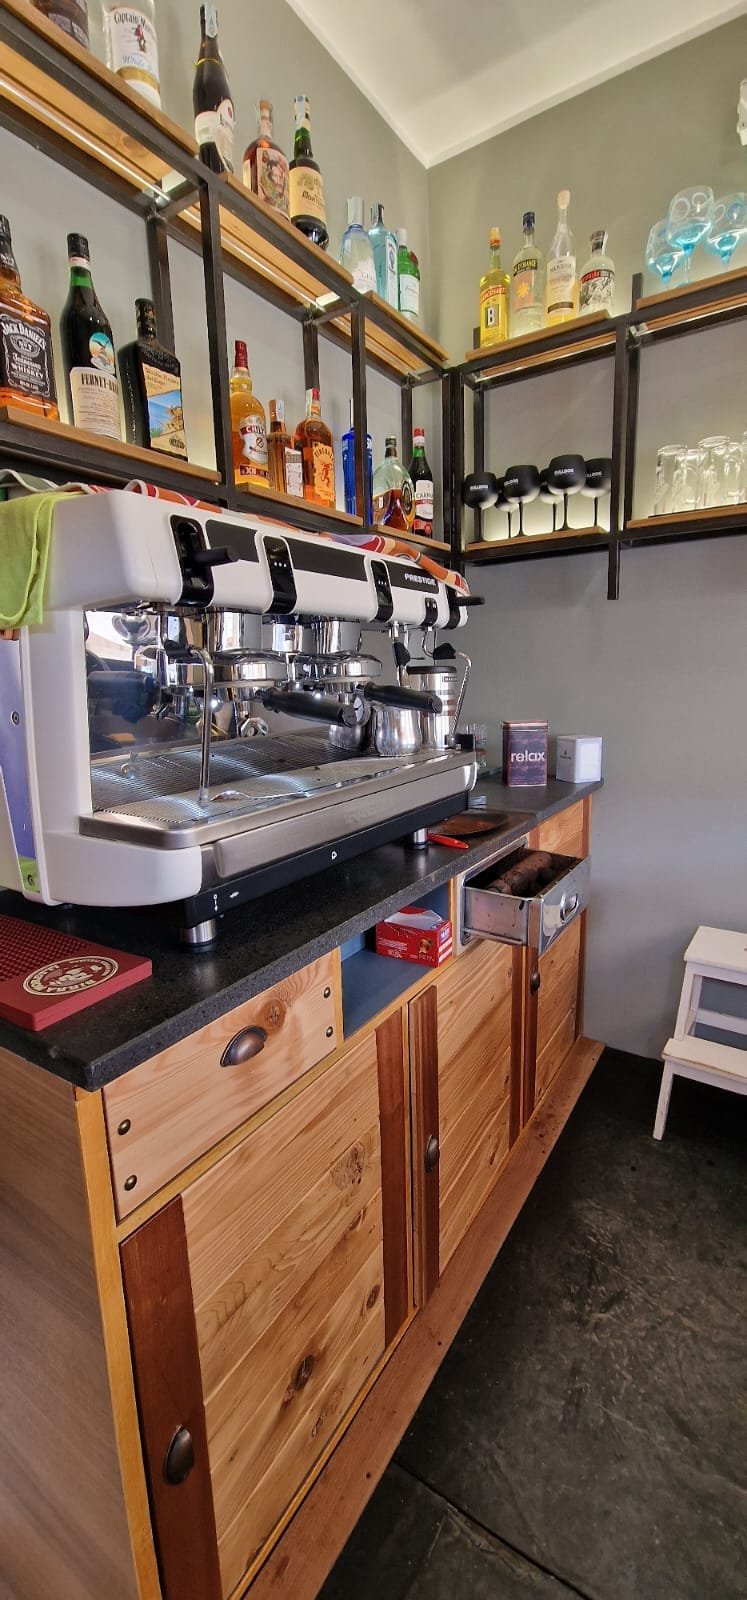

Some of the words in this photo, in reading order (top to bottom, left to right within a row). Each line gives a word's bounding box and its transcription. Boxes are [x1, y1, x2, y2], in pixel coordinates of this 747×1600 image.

[114, 11, 139, 24] Captain
[487, 307, 495, 326] B
[1, 321, 20, 336] JACK
[404, 573, 437, 586] PRESTIGE
[510, 749, 546, 763] relax
